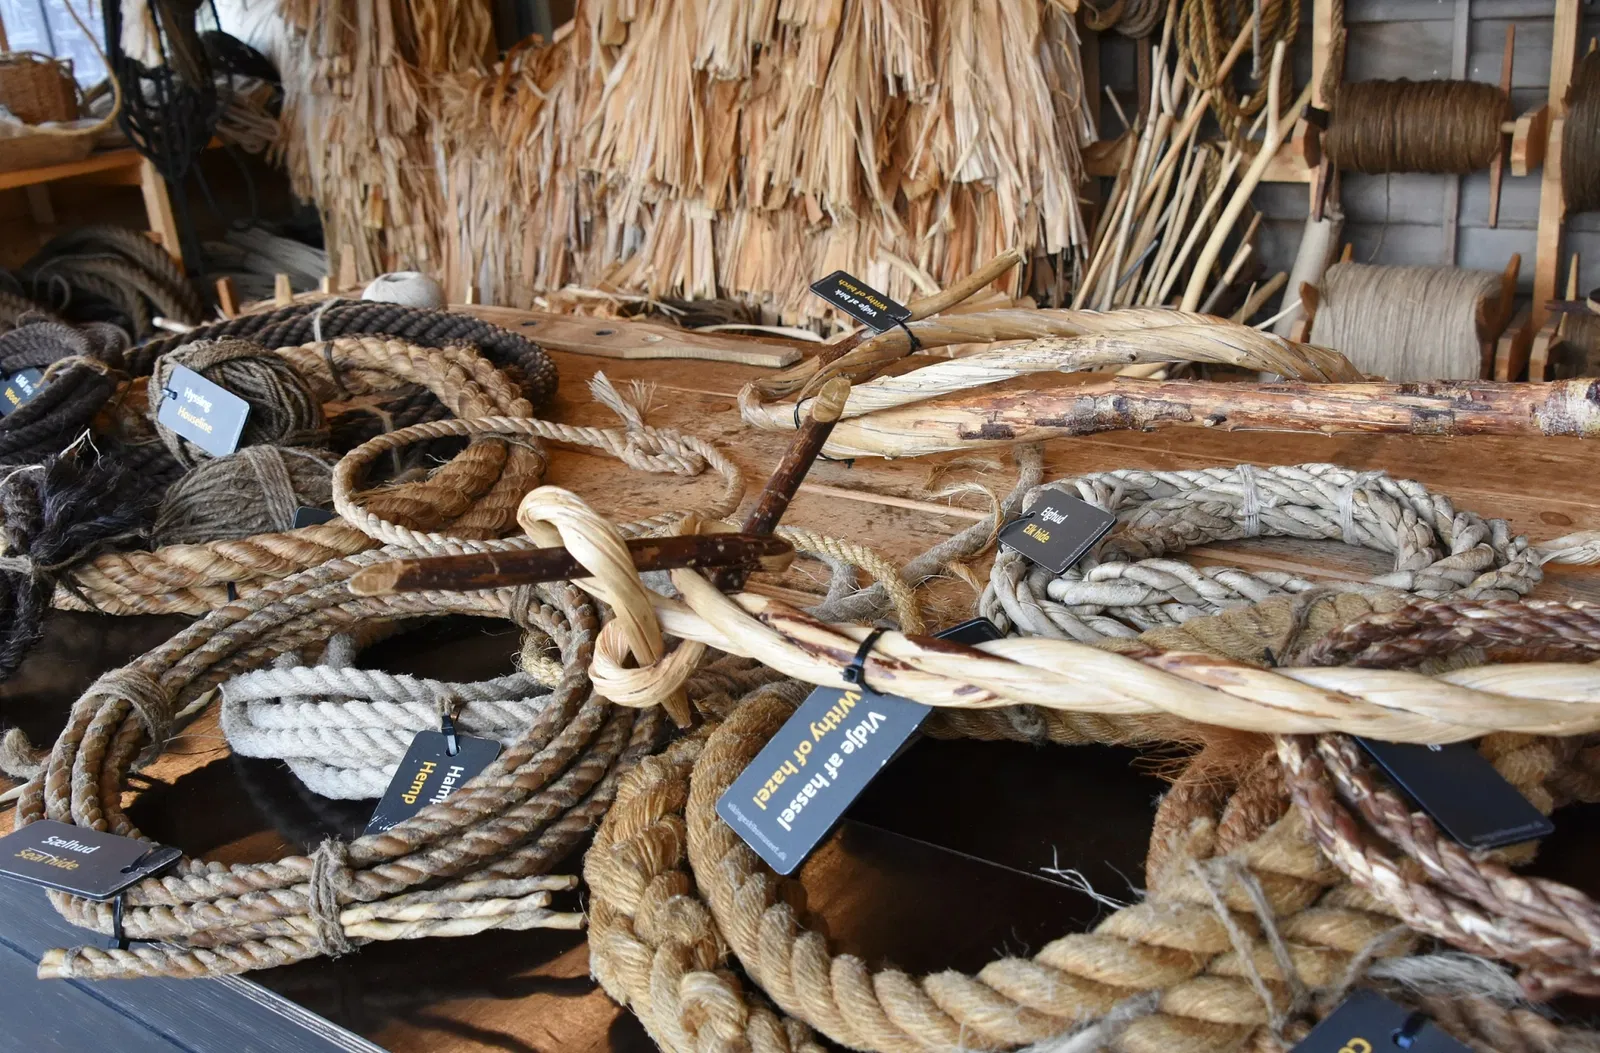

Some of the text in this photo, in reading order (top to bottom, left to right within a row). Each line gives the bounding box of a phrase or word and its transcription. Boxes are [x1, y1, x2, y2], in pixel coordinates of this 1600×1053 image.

[834, 288, 851, 301] birk
[838, 279, 858, 293] birch
[858, 303, 878, 318] Vidje
[865, 294, 888, 311] Withy
[4, 387, 21, 405] Wool
[183, 386, 213, 414] Hyssing
[177, 405, 213, 434] Houseline
[1040, 506, 1069, 525] Elghud
[1023, 523, 1051, 544] Elk hide
[752, 690, 862, 811] Withy of hazel
[776, 711, 887, 832] Vidje af hassel
[402, 761, 437, 804] Hemp
[41, 835, 101, 854] Sælhud
[14, 848, 80, 871] Seal hide
